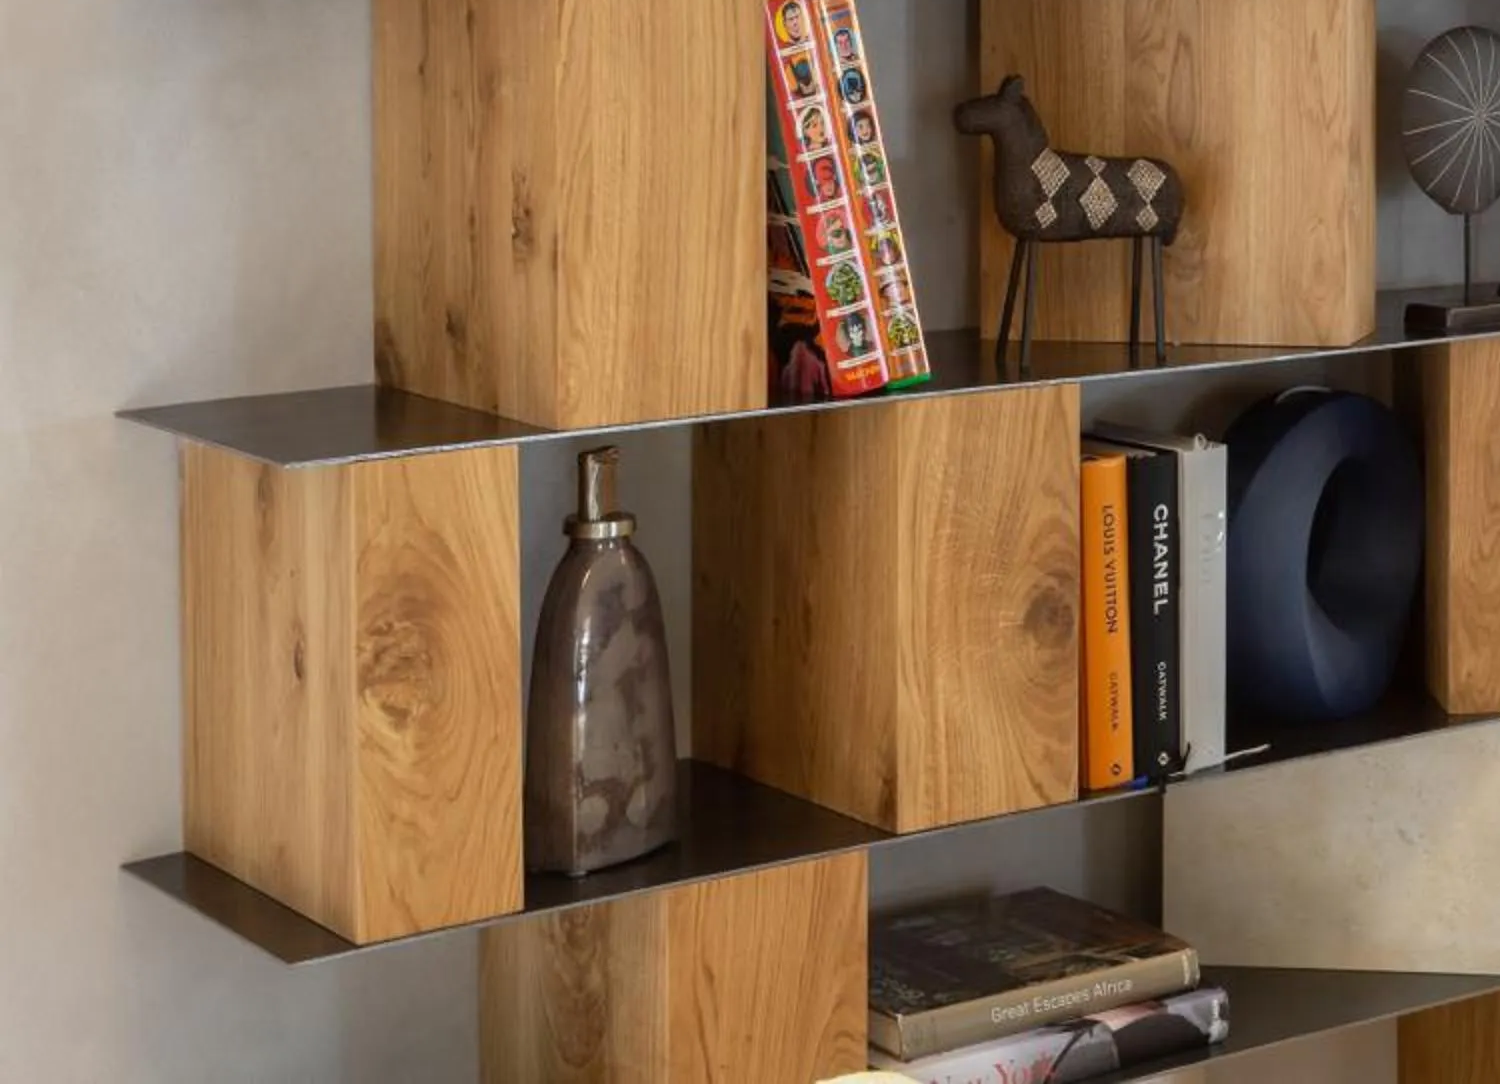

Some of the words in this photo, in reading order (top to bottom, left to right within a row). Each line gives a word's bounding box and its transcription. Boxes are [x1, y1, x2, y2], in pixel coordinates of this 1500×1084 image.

[1102, 504, 1114, 555] LOUIS
[1152, 503, 1170, 617] CHANEL
[1104, 560, 1118, 635] VUITTON
[1108, 672, 1119, 734] CATWALK
[1156, 661, 1168, 722] CATWALK
[990, 1003, 1030, 1024] Great
[1032, 988, 1090, 1014] Escapes
[1093, 975, 1133, 998] Africa
